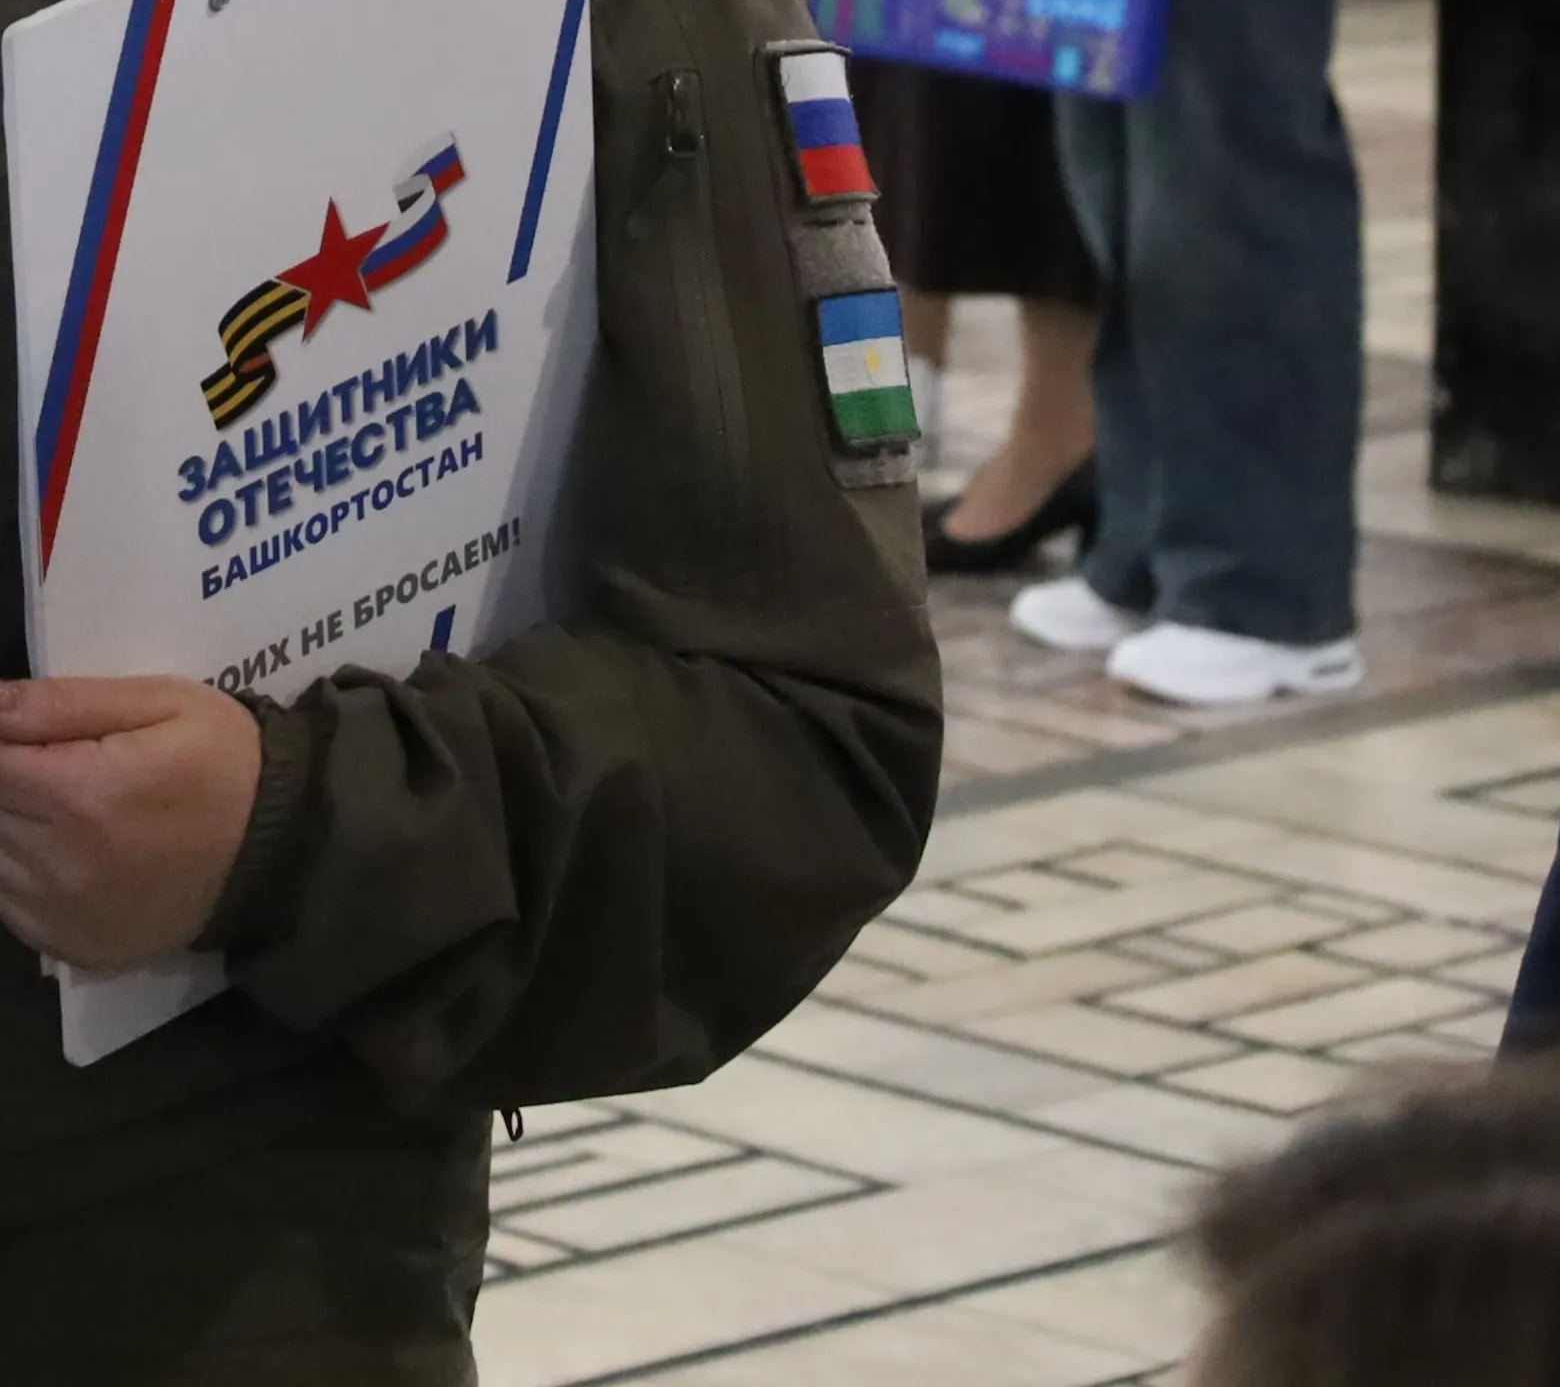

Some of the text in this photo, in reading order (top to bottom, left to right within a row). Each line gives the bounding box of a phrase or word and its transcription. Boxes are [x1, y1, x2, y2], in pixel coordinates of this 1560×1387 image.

[177, 307, 500, 502] ЗАЩИТНИКИ
[197, 377, 481, 549] ОТЕЧЕСТВА
[201, 432, 484, 600] БАШКОРТОСТАН
[202, 518, 522, 694] ОИХ НЕ БРОСАЕМ!
